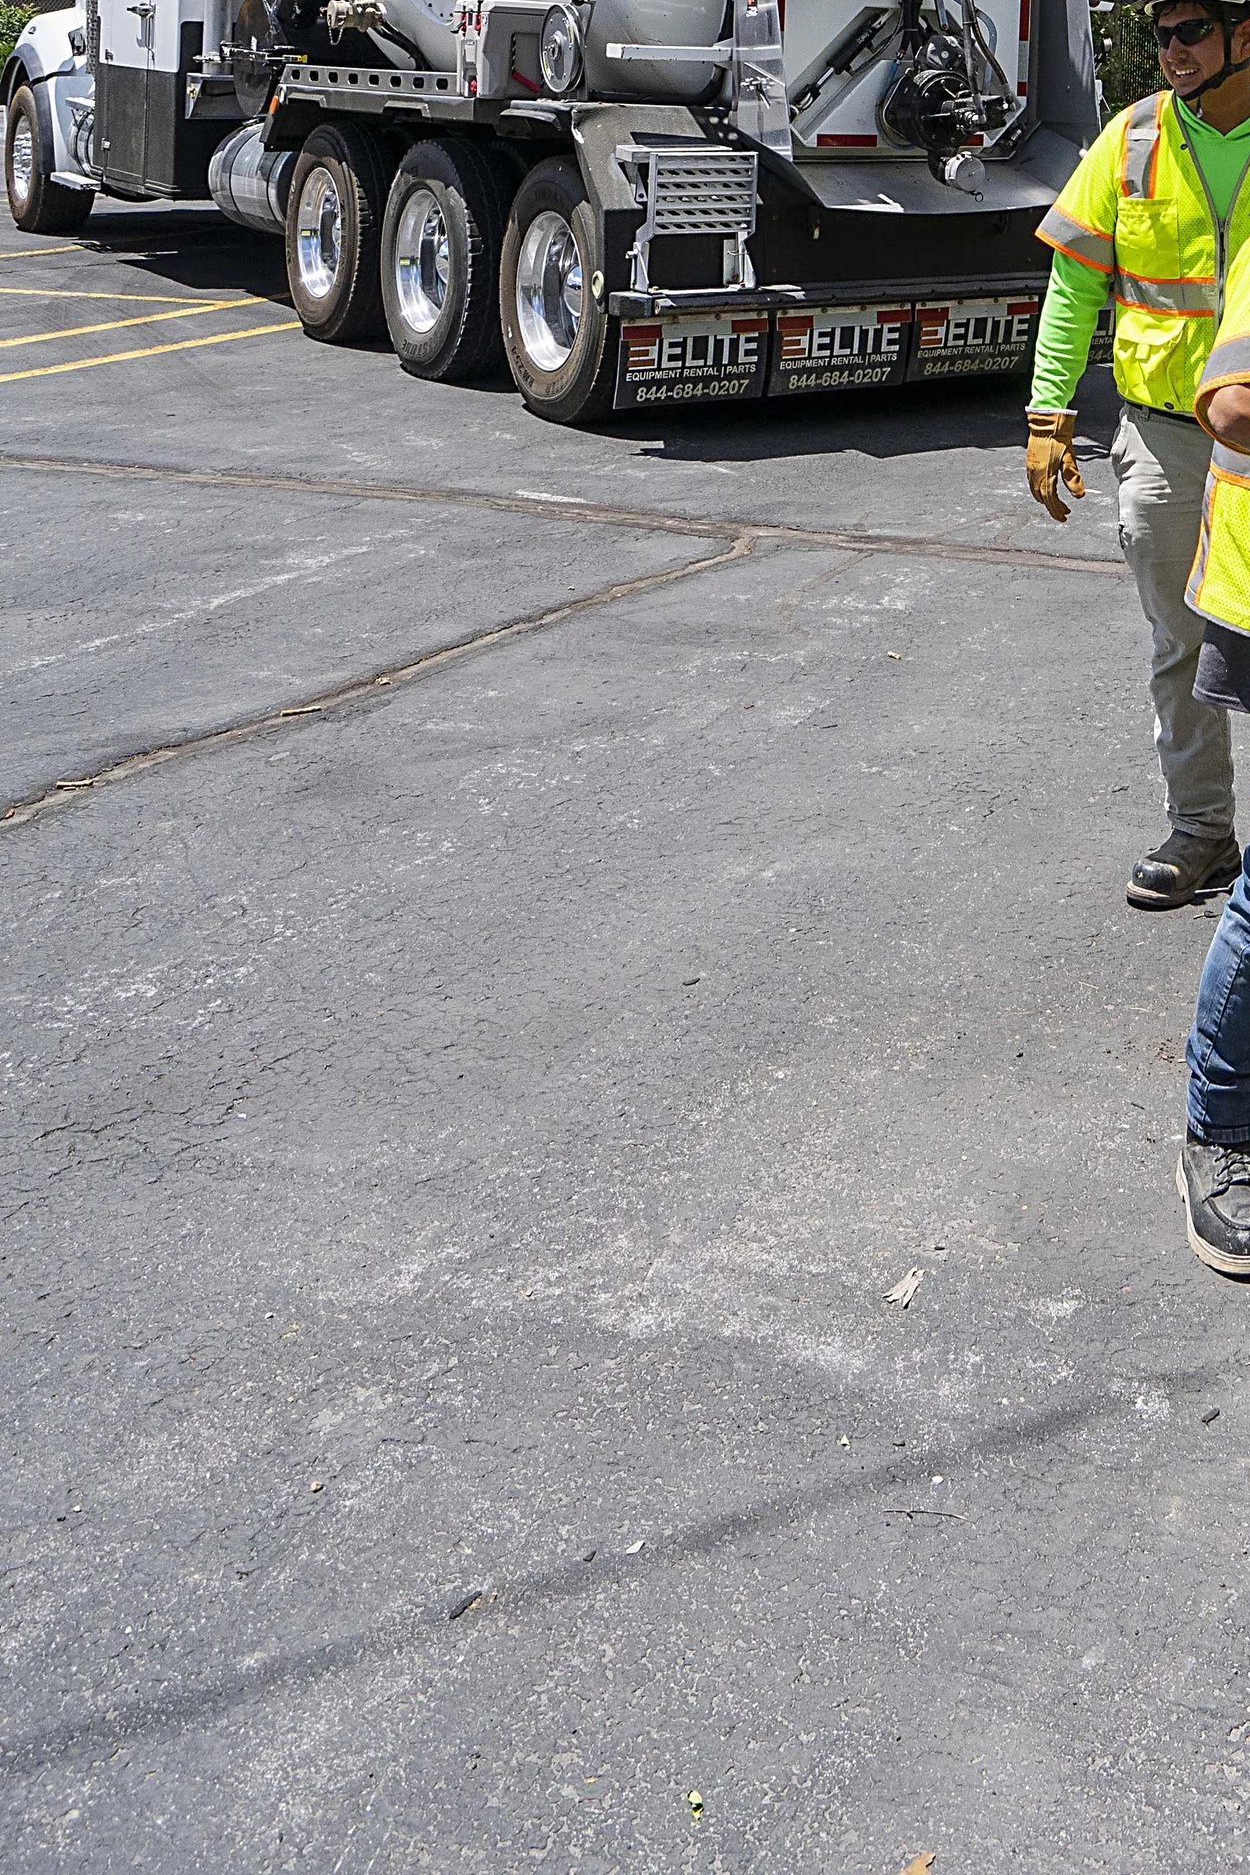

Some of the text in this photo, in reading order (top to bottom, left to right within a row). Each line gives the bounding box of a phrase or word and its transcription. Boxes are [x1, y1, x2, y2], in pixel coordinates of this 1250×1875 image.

[811, 323, 901, 358] ELITE
[947, 313, 1030, 347] ELITE
[661, 332, 759, 368] ELITE
[779, 352, 898, 370] EQUIPMENT RENTAL PARTS
[917, 342, 1026, 358] EQUIPMENT RENTAL PARTS
[626, 364, 756, 382] EQUIPMENT RENTAL PARTS
[924, 356, 1019, 376] 844-684-0207
[788, 367, 891, 390] 844-684-0207
[636, 379, 750, 402] 844-684-0207
